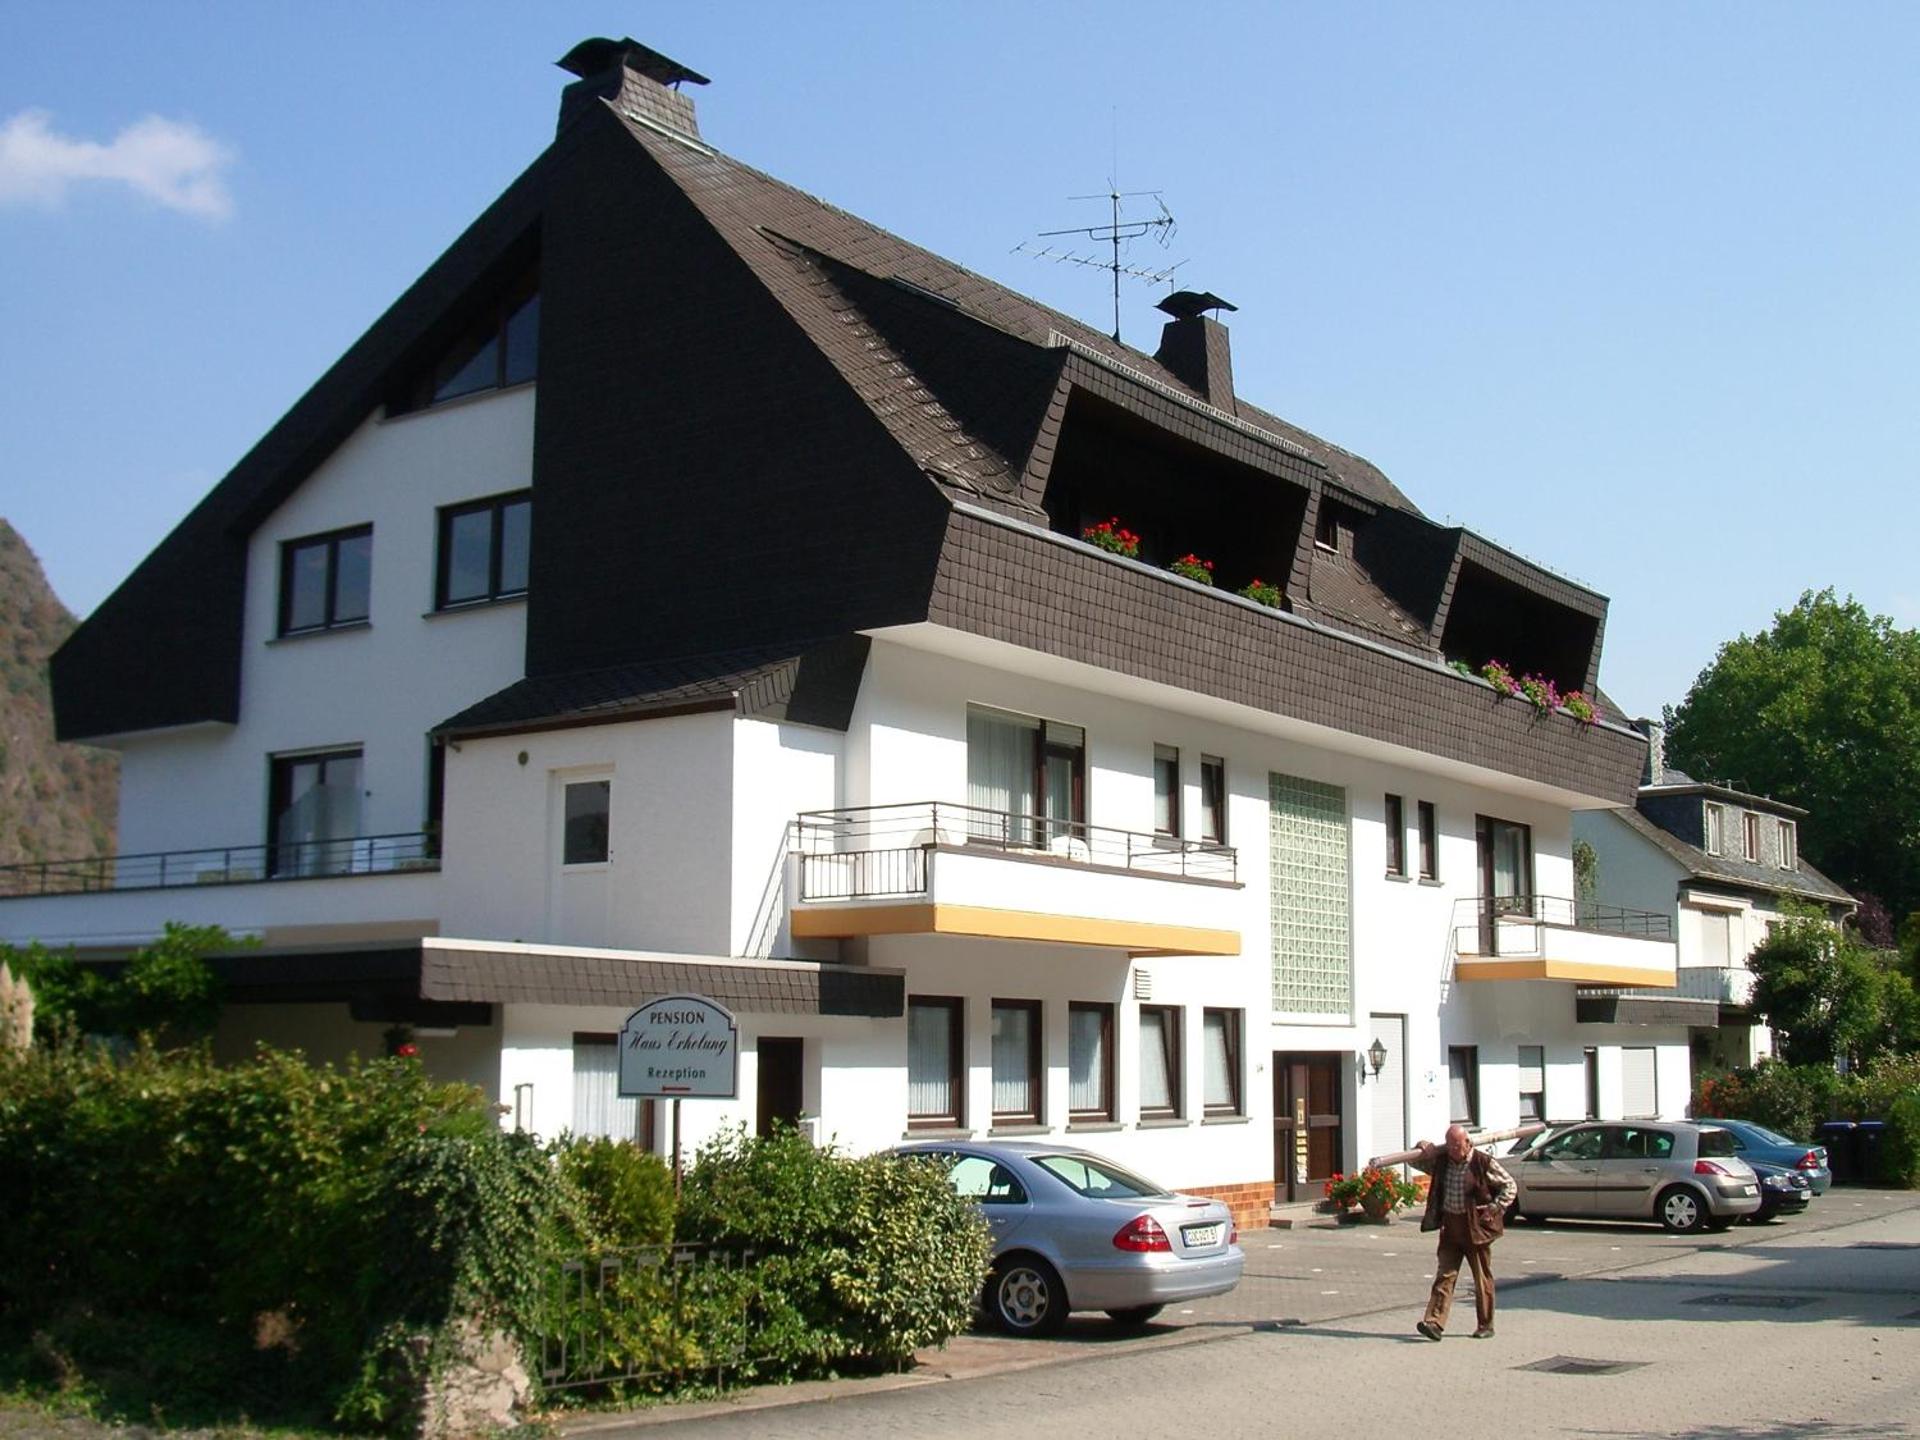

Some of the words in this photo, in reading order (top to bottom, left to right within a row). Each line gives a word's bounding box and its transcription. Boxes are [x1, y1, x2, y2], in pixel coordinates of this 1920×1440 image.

[649, 1011, 705, 1025] PENSION
[629, 1031, 662, 1051] Haus
[647, 1066, 706, 1081] Rezeption
